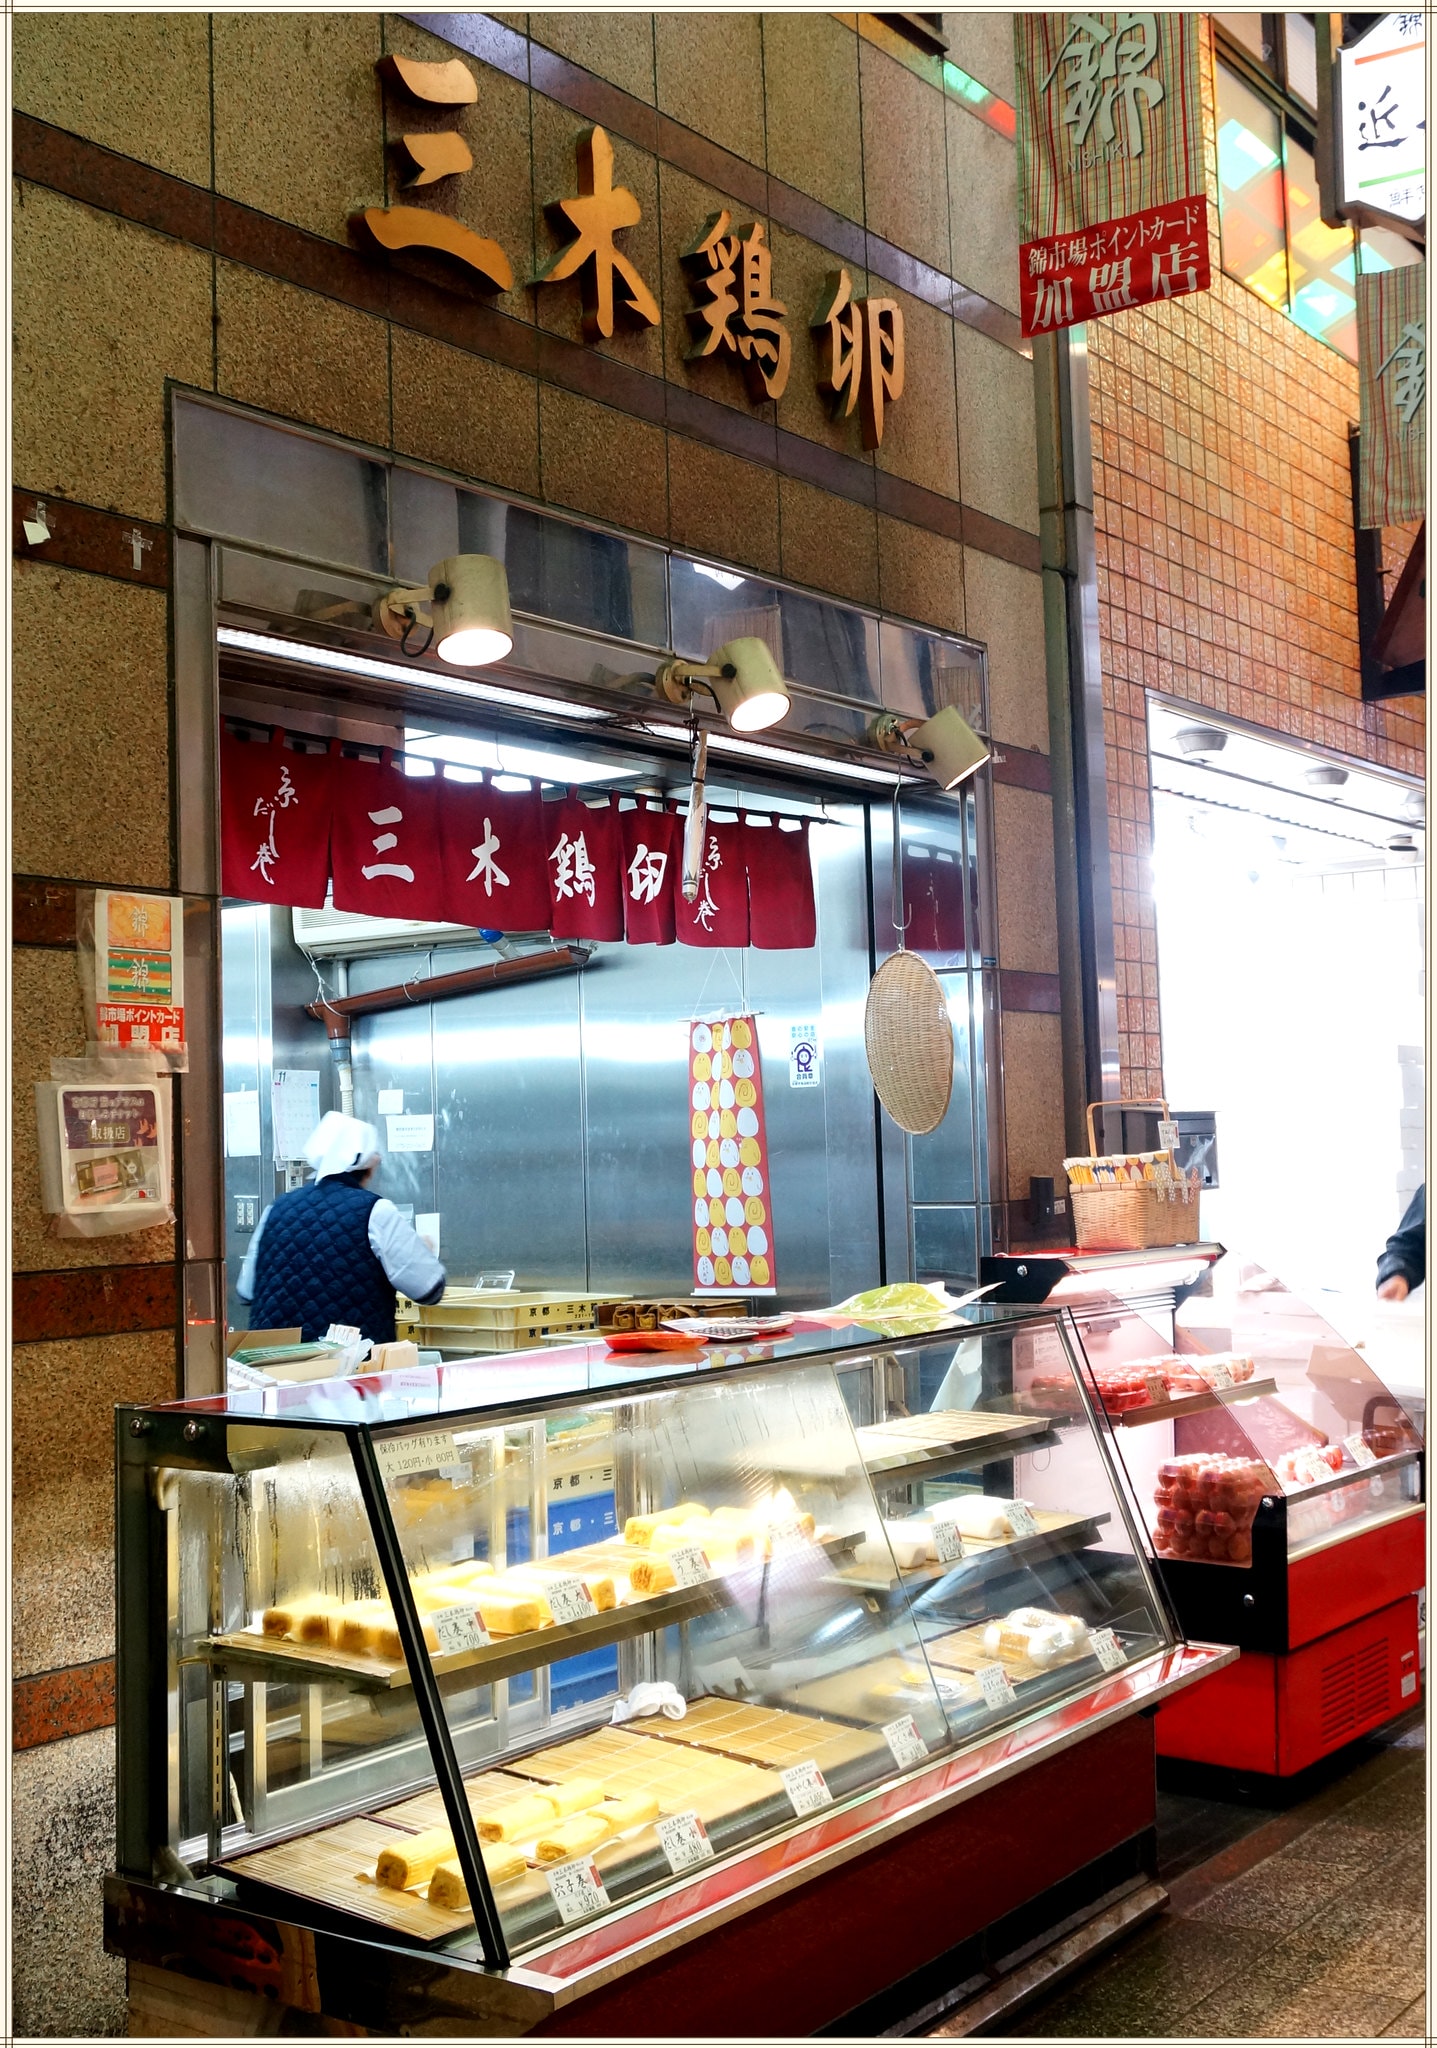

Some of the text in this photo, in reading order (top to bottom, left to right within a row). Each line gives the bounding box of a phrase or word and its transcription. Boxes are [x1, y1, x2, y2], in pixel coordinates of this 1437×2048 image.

[1358, 85, 1425, 151] 近
[1068, 139, 1129, 172] NISHIKI
[350, 54, 905, 450] 三木鶏卵
[1028, 204, 1200, 277] 錦市場ポイントカード
[1030, 241, 1199, 331] 加盟店
[361, 806, 667, 907] 三木鶏卵
[379, 1434, 448, 1455] 保冷バッグ有ります
[554, 1873, 587, 1897] 穴子巻
